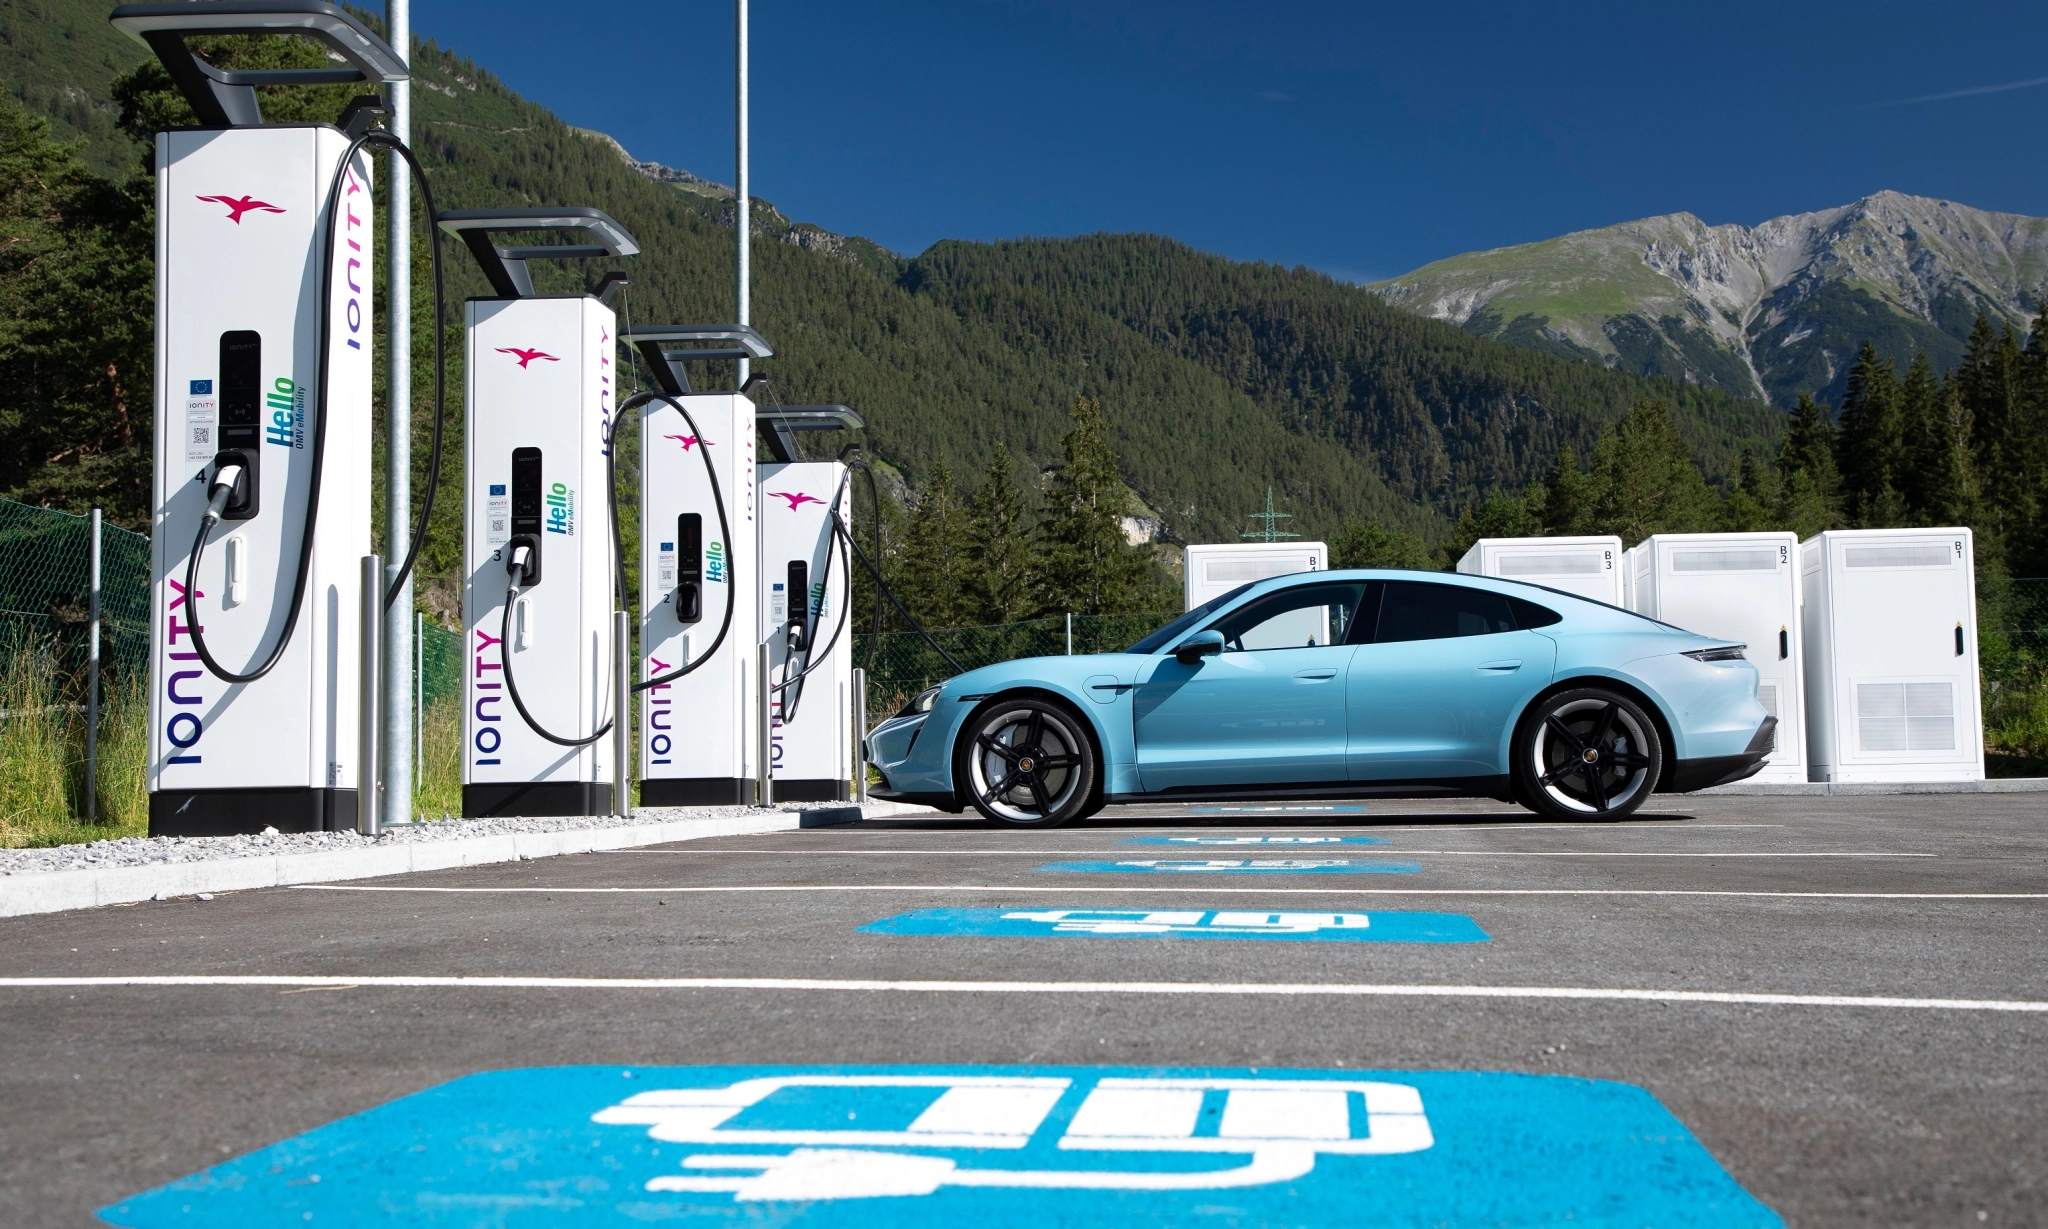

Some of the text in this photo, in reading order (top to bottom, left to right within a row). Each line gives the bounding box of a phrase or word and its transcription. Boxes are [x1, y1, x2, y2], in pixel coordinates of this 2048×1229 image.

[347, 166, 361, 351] IONITY
[601, 324, 609, 457] IONITY
[266, 377, 295, 448] Hello
[295, 386, 307, 450] OMV eMobility
[195, 468, 207, 484] 4
[546, 482, 567, 535] Hello
[567, 489, 576, 521] eMobility
[493, 549, 502, 562] 3
[1605, 551, 1611, 559] B
[1780, 546, 1787, 554] B
[1955, 541, 1962, 550] B
[706, 541, 722, 583] Hello
[1310, 556, 1316, 565] B
[1605, 561, 1612, 569] 3
[1781, 555, 1787, 563] 2
[663, 593, 671, 604] 2
[776, 626, 781, 635] 1
[166, 578, 205, 765] IONITY
[475, 629, 502, 766] IONITY
[650, 656, 672, 765] IONITY
